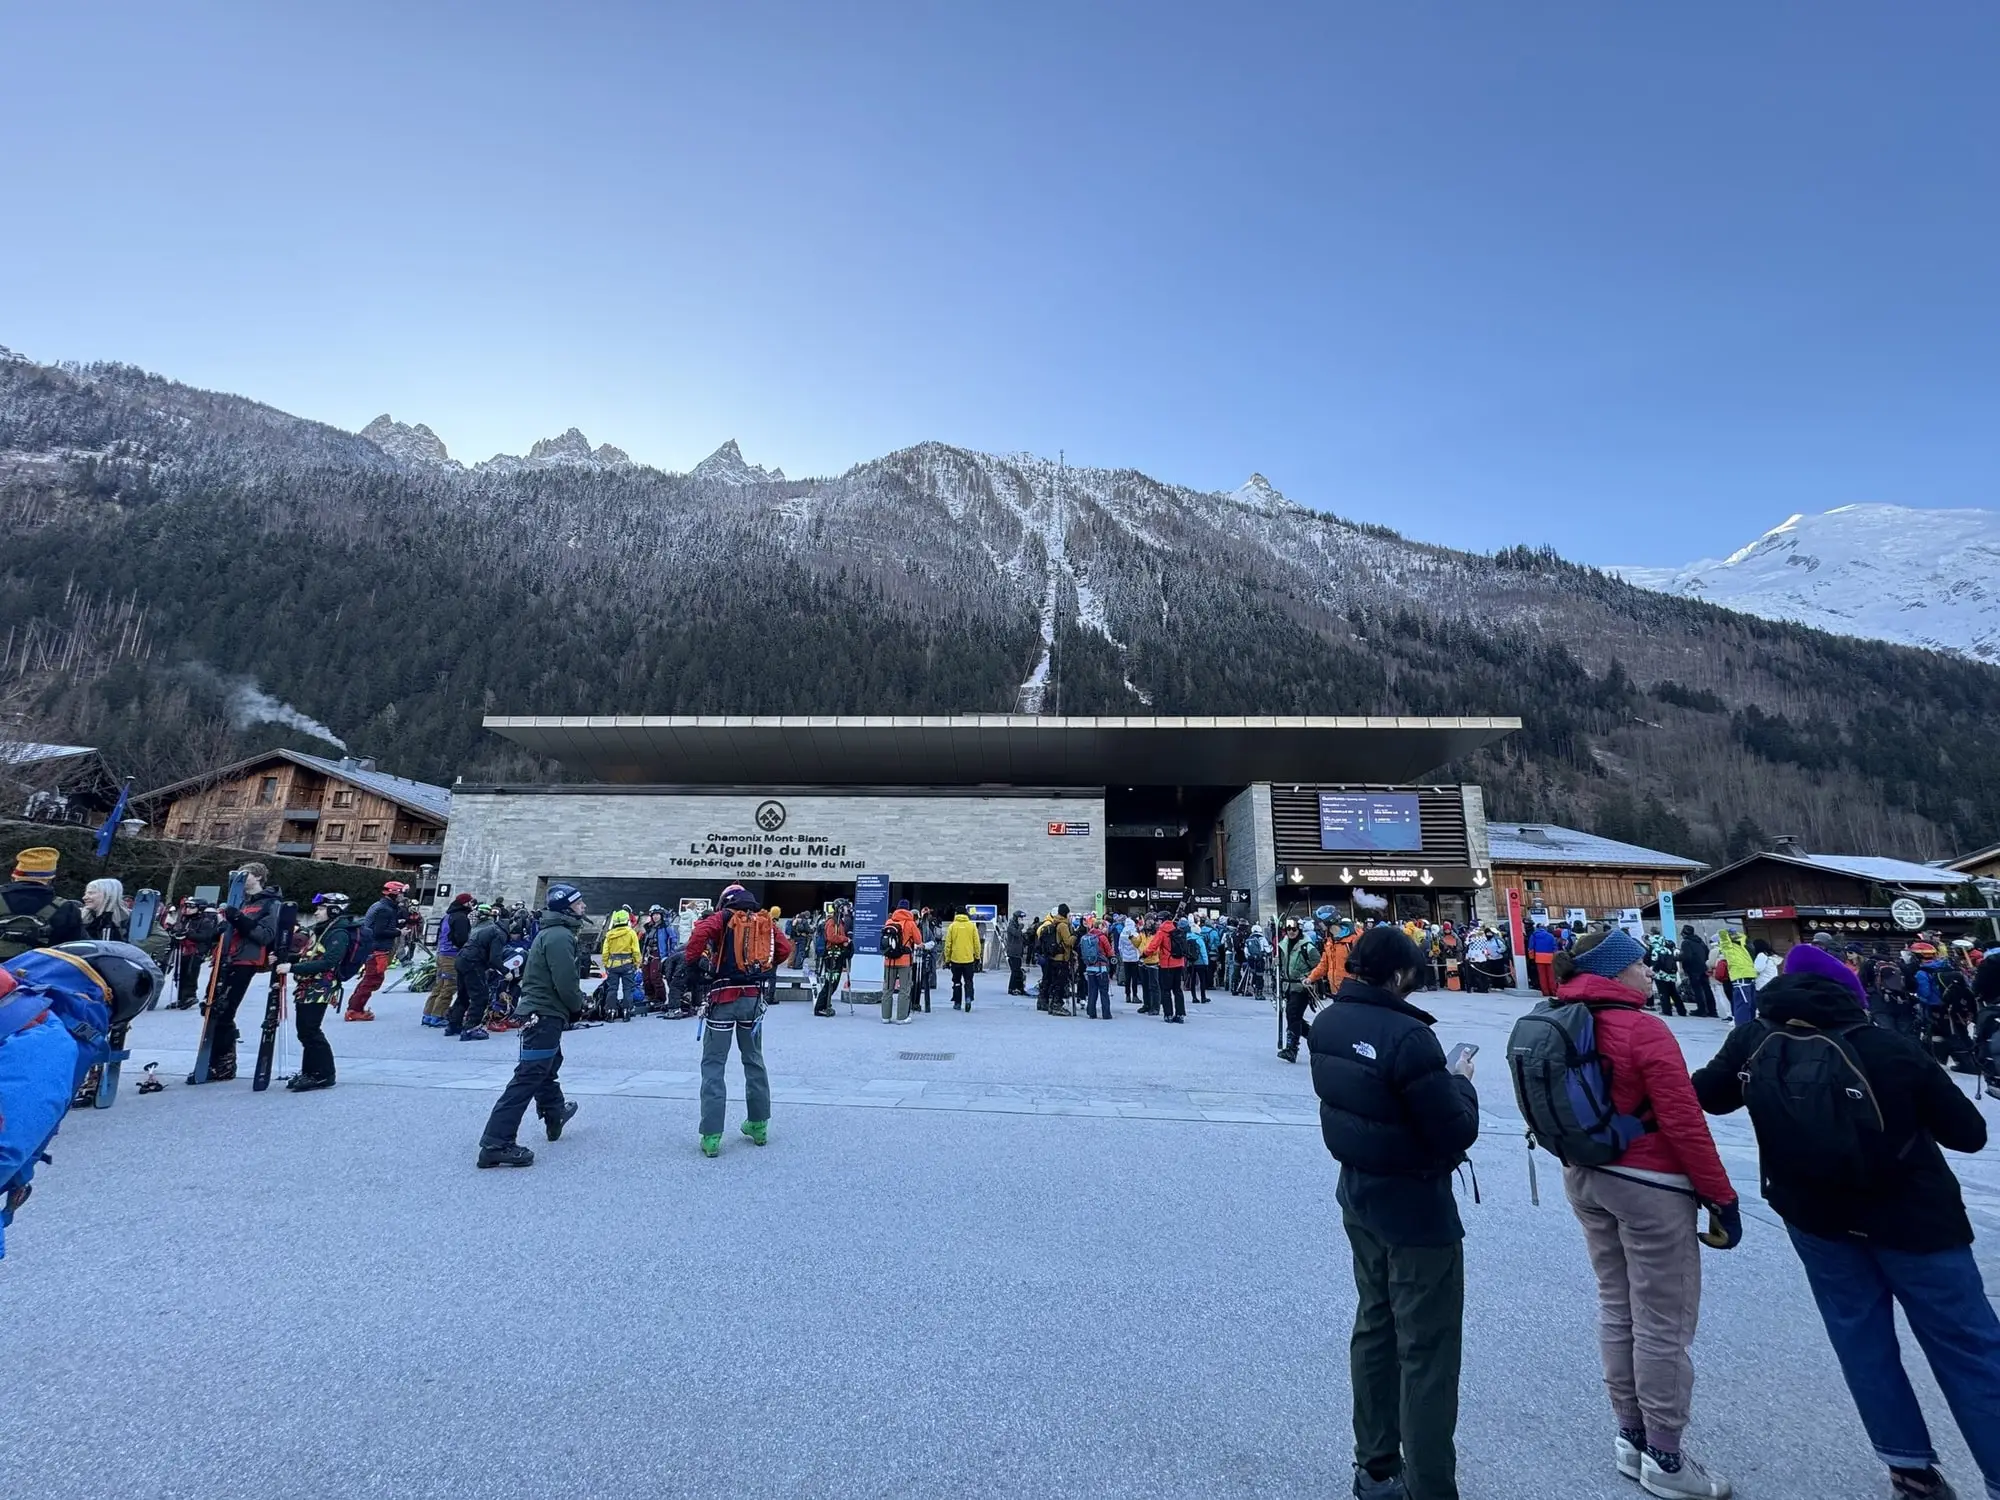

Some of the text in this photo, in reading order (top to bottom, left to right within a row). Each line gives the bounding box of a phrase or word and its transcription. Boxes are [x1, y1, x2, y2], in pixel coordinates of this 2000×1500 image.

[707, 833, 829, 843] Chamonix Mont-Blanc
[690, 843, 846, 858] L'Aiguille du Midi
[669, 858, 866, 869] Téléphérique de l'Aiguille du Midi
[1358, 869, 1389, 877] CAISSES
